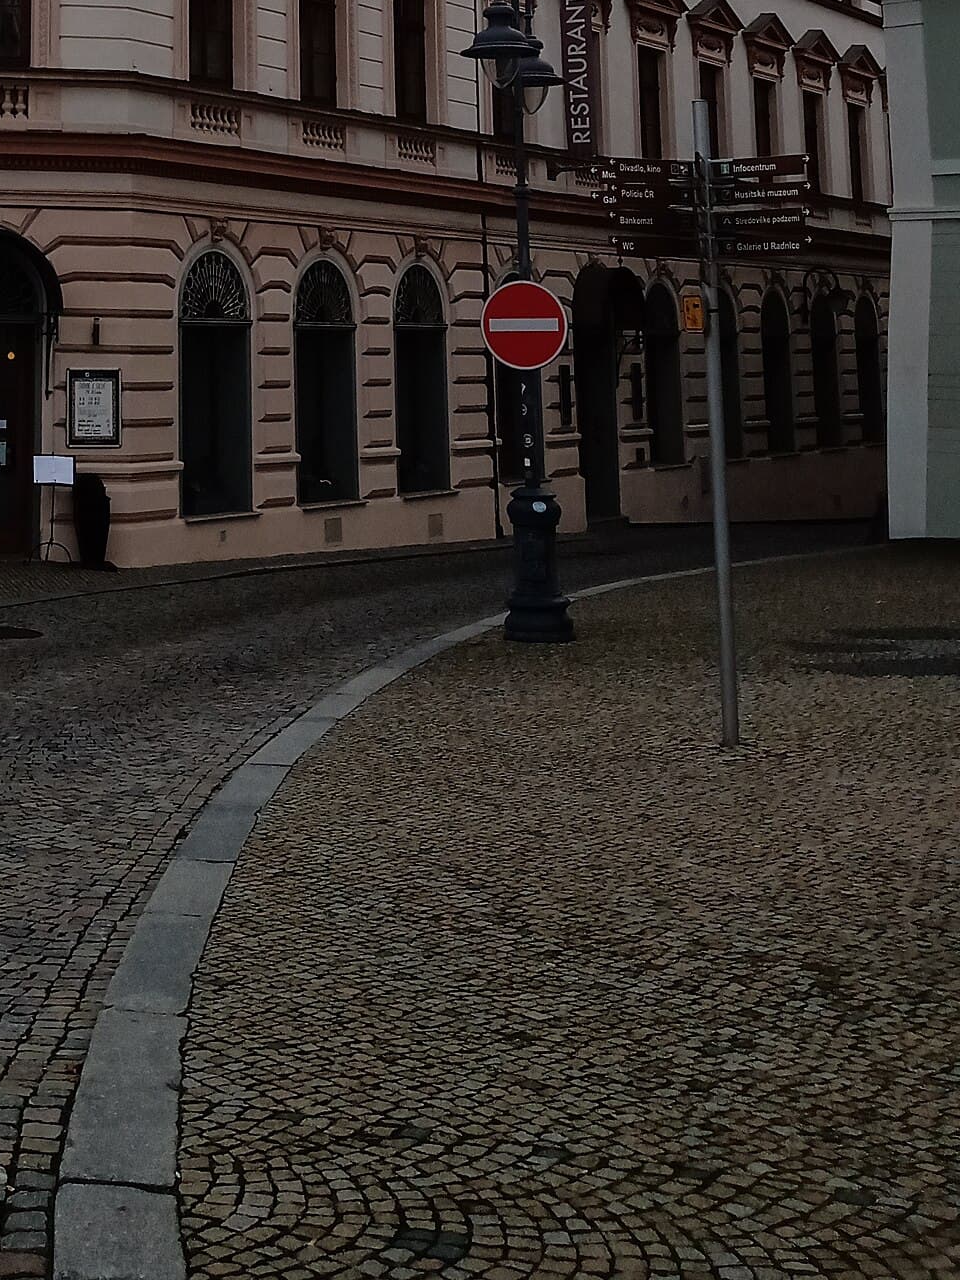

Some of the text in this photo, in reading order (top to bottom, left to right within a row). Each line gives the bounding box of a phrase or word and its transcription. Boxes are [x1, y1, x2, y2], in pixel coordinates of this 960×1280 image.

[619, 163, 661, 174] Divadlo, kino
[732, 163, 777, 173] Infocentrum
[619, 216, 653, 225] Bankomat
[622, 242, 635, 251] WC
[763, 242, 769, 250] U
[771, 241, 800, 250] Radnice
